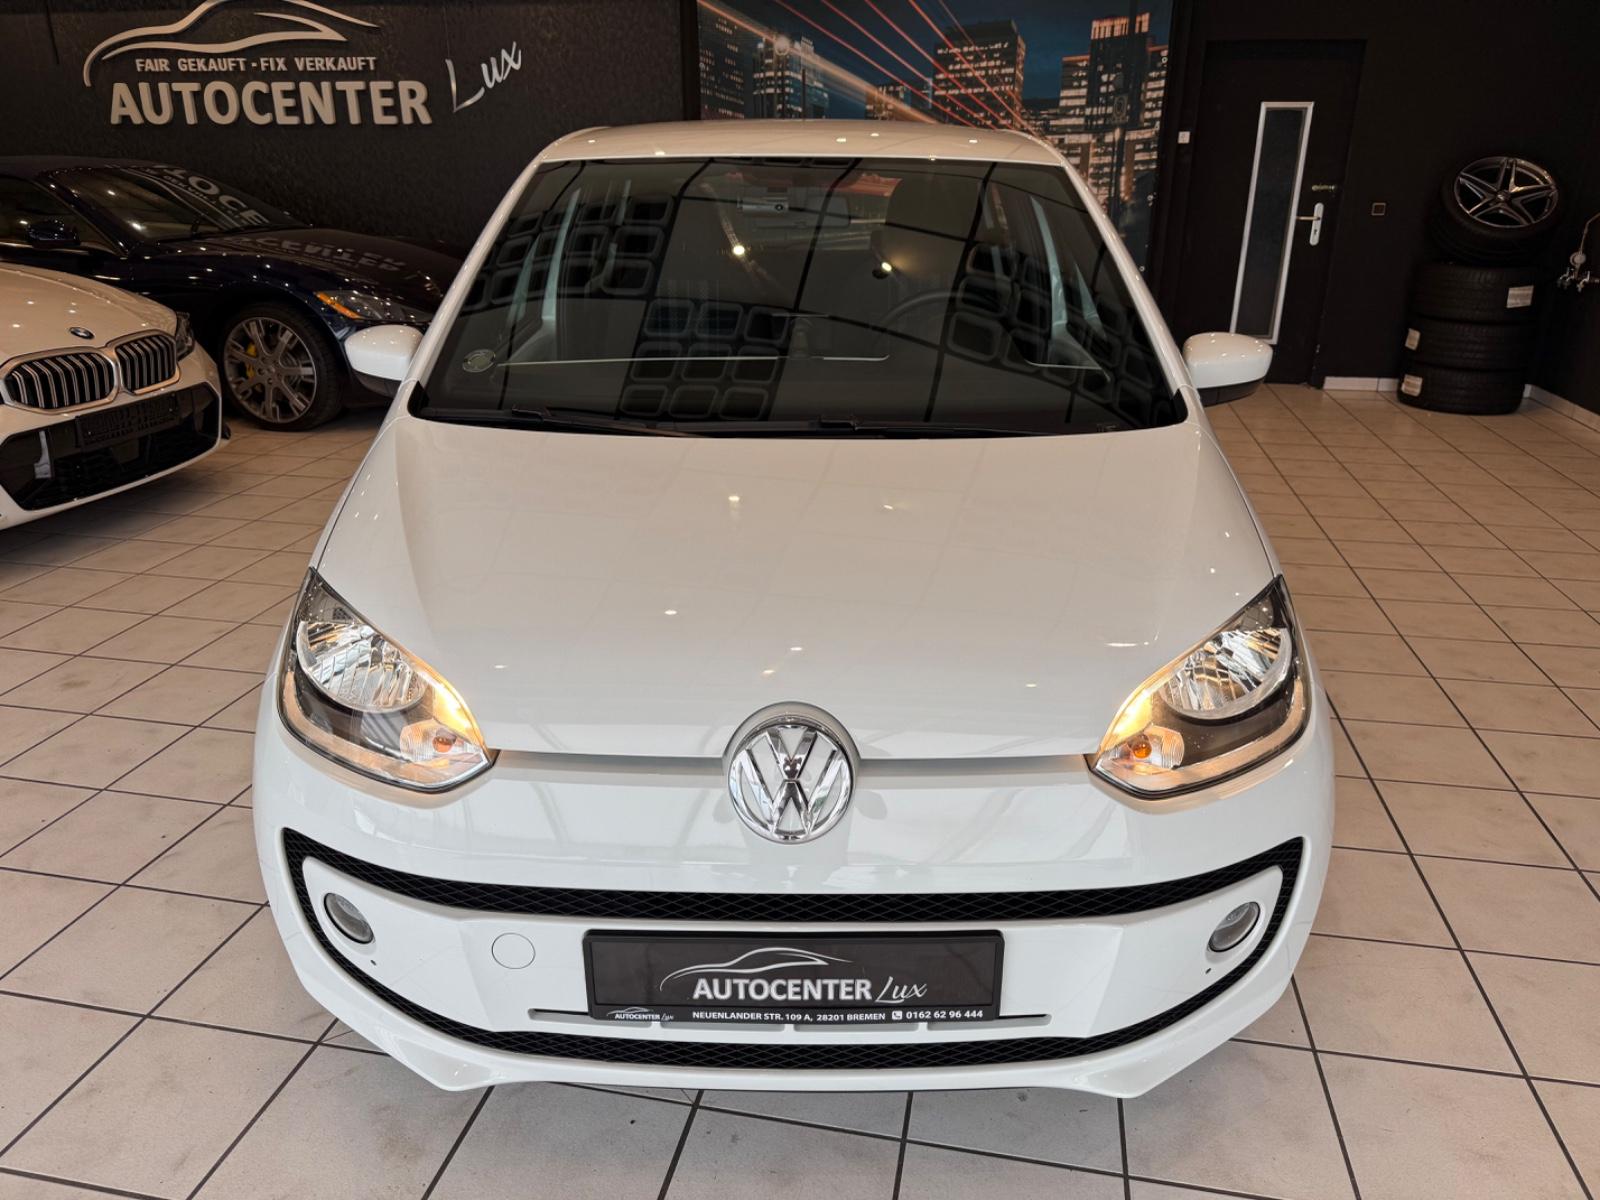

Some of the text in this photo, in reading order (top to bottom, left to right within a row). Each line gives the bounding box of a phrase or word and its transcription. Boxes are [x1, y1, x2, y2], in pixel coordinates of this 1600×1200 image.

[135, 58, 170, 72] FAIR
[177, 57, 247, 72] GEKAUFT
[260, 57, 288, 72] FIX
[295, 56, 377, 71] VERKAUFT
[110, 41, 522, 125] AUTOCENTER Lux
[730, 725, 853, 839] VW
[692, 976, 928, 1004] AUTOCENTER Lux
[614, 1012, 661, 1021] AUTOCENTER
[763, 1012, 784, 1021] STR.
[785, 1013, 803, 1022] 109
[816, 1013, 845, 1022] 28201
[846, 1012, 886, 1021] BREMEN
[905, 1010, 932, 1020] 0162
[933, 1010, 947, 1019] 62
[948, 1010, 962, 1019] 96
[963, 1009, 983, 1019] 444
